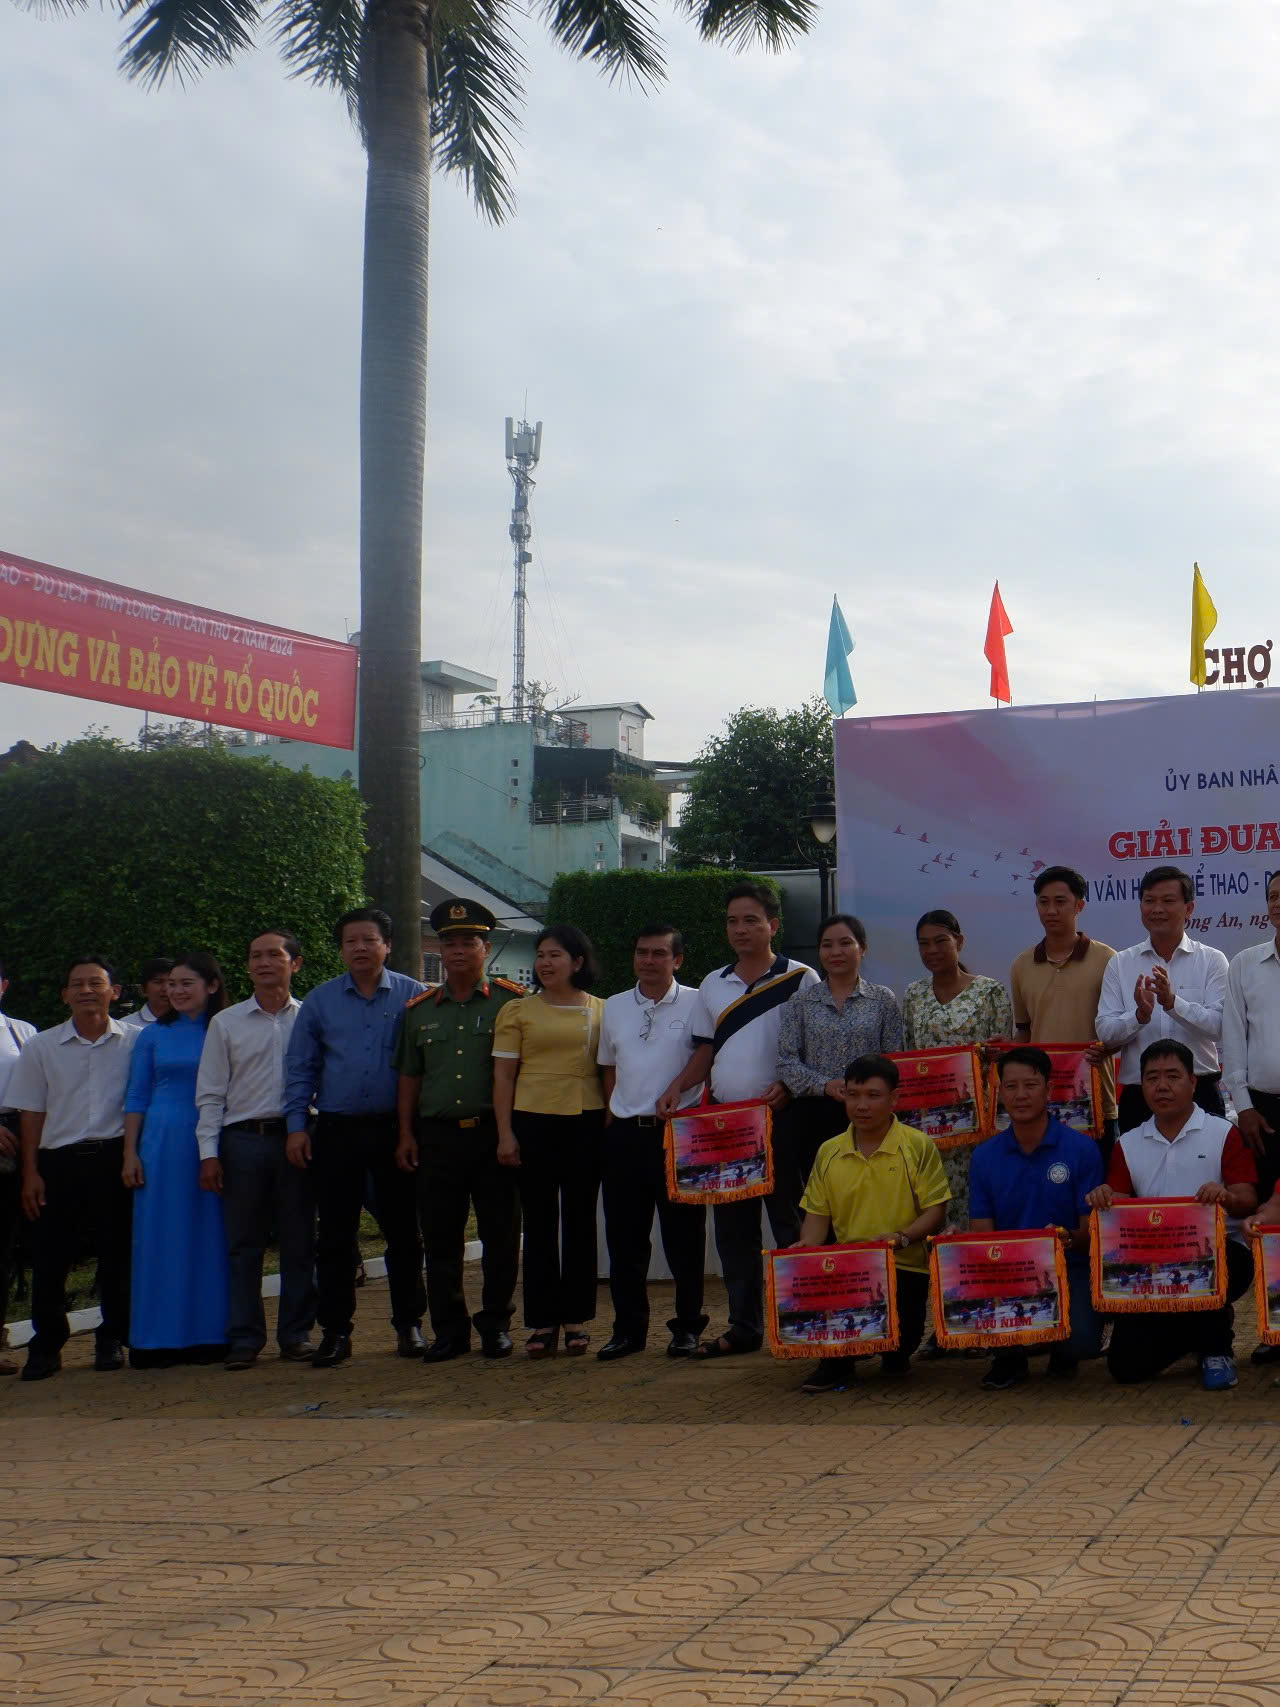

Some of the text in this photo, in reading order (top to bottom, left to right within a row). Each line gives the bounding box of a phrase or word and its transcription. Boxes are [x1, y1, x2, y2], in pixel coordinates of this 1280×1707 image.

[125, 597, 161, 622] LONG
[163, 607, 182, 628] AN
[232, 627, 239, 643] 2
[269, 637, 293, 656] 2024
[87, 630, 121, 687] VÀ
[127, 636, 181, 699] BẢO
[187, 654, 218, 715] VỆ
[223, 653, 253, 713] TỔ
[257, 669, 319, 728] QUỐC
[1204, 639, 1274, 688] CHỢ
[1165, 768, 1191, 791] ỦY
[1197, 770, 1234, 790] BAN
[1108, 819, 1192, 860] GIẢI
[1094, 874, 1127, 902] VĂN
[1209, 871, 1249, 897] THAO
[1216, 911, 1243, 930] An,
